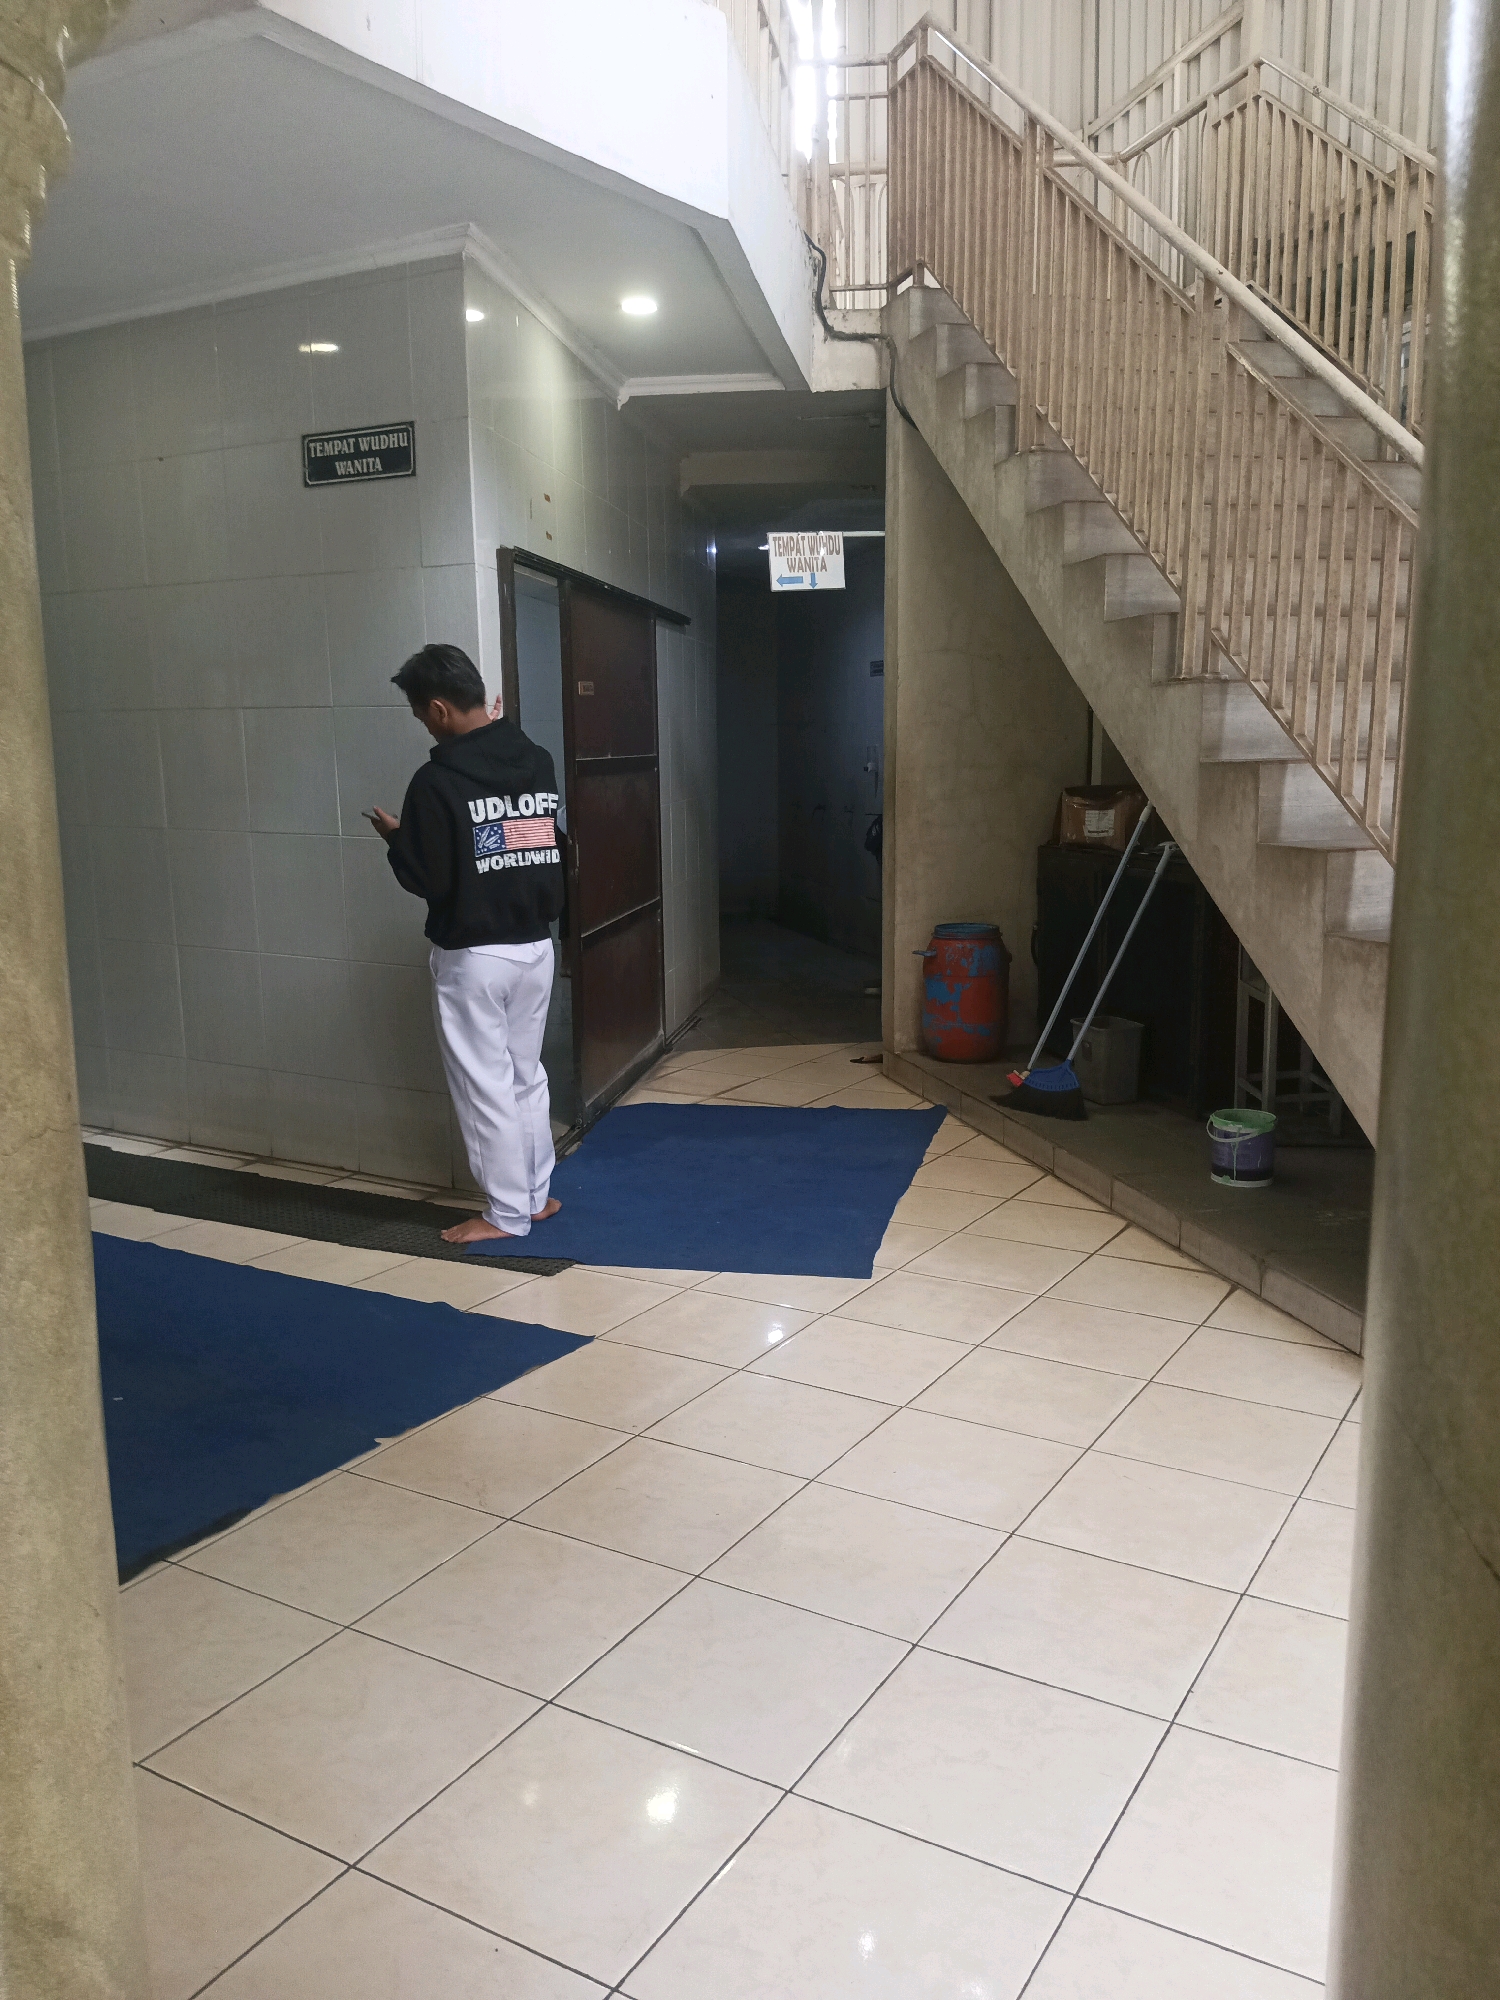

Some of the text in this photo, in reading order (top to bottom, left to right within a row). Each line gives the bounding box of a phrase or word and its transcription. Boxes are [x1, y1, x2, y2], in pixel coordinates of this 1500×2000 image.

[309, 432, 408, 457] TEMPAT WUDHU
[335, 457, 382, 475] WANITA
[773, 536, 805, 556] TEMPAT
[787, 557, 827, 572] WANITA
[468, 792, 558, 823] UDLOFF
